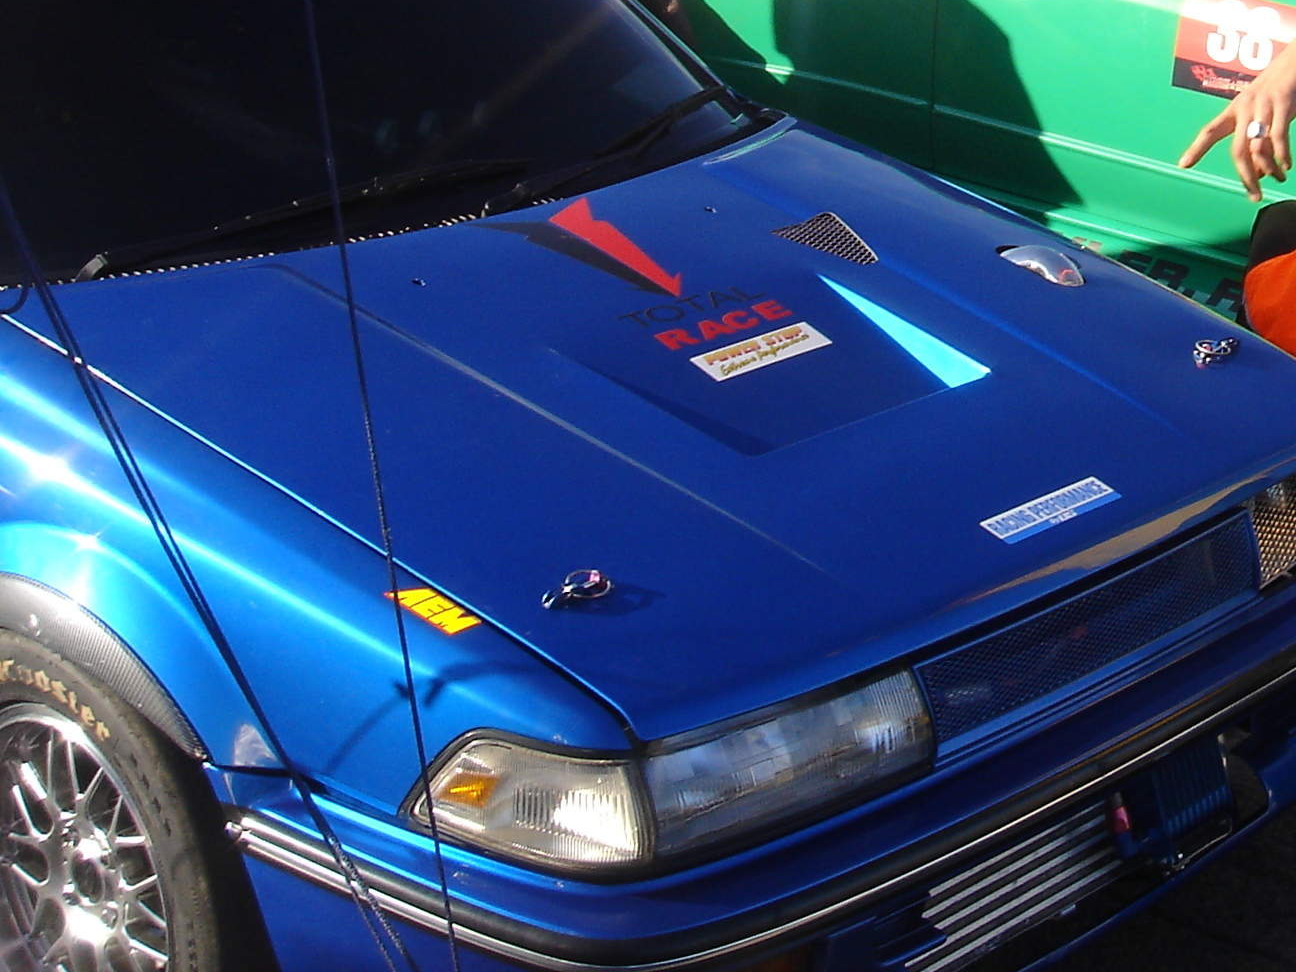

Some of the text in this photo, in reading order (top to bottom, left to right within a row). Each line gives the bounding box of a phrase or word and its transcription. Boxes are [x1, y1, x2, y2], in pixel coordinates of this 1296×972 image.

[615, 286, 767, 328] TOTAL
[654, 299, 793, 351] RACE
[383, 587, 482, 636] AEM
